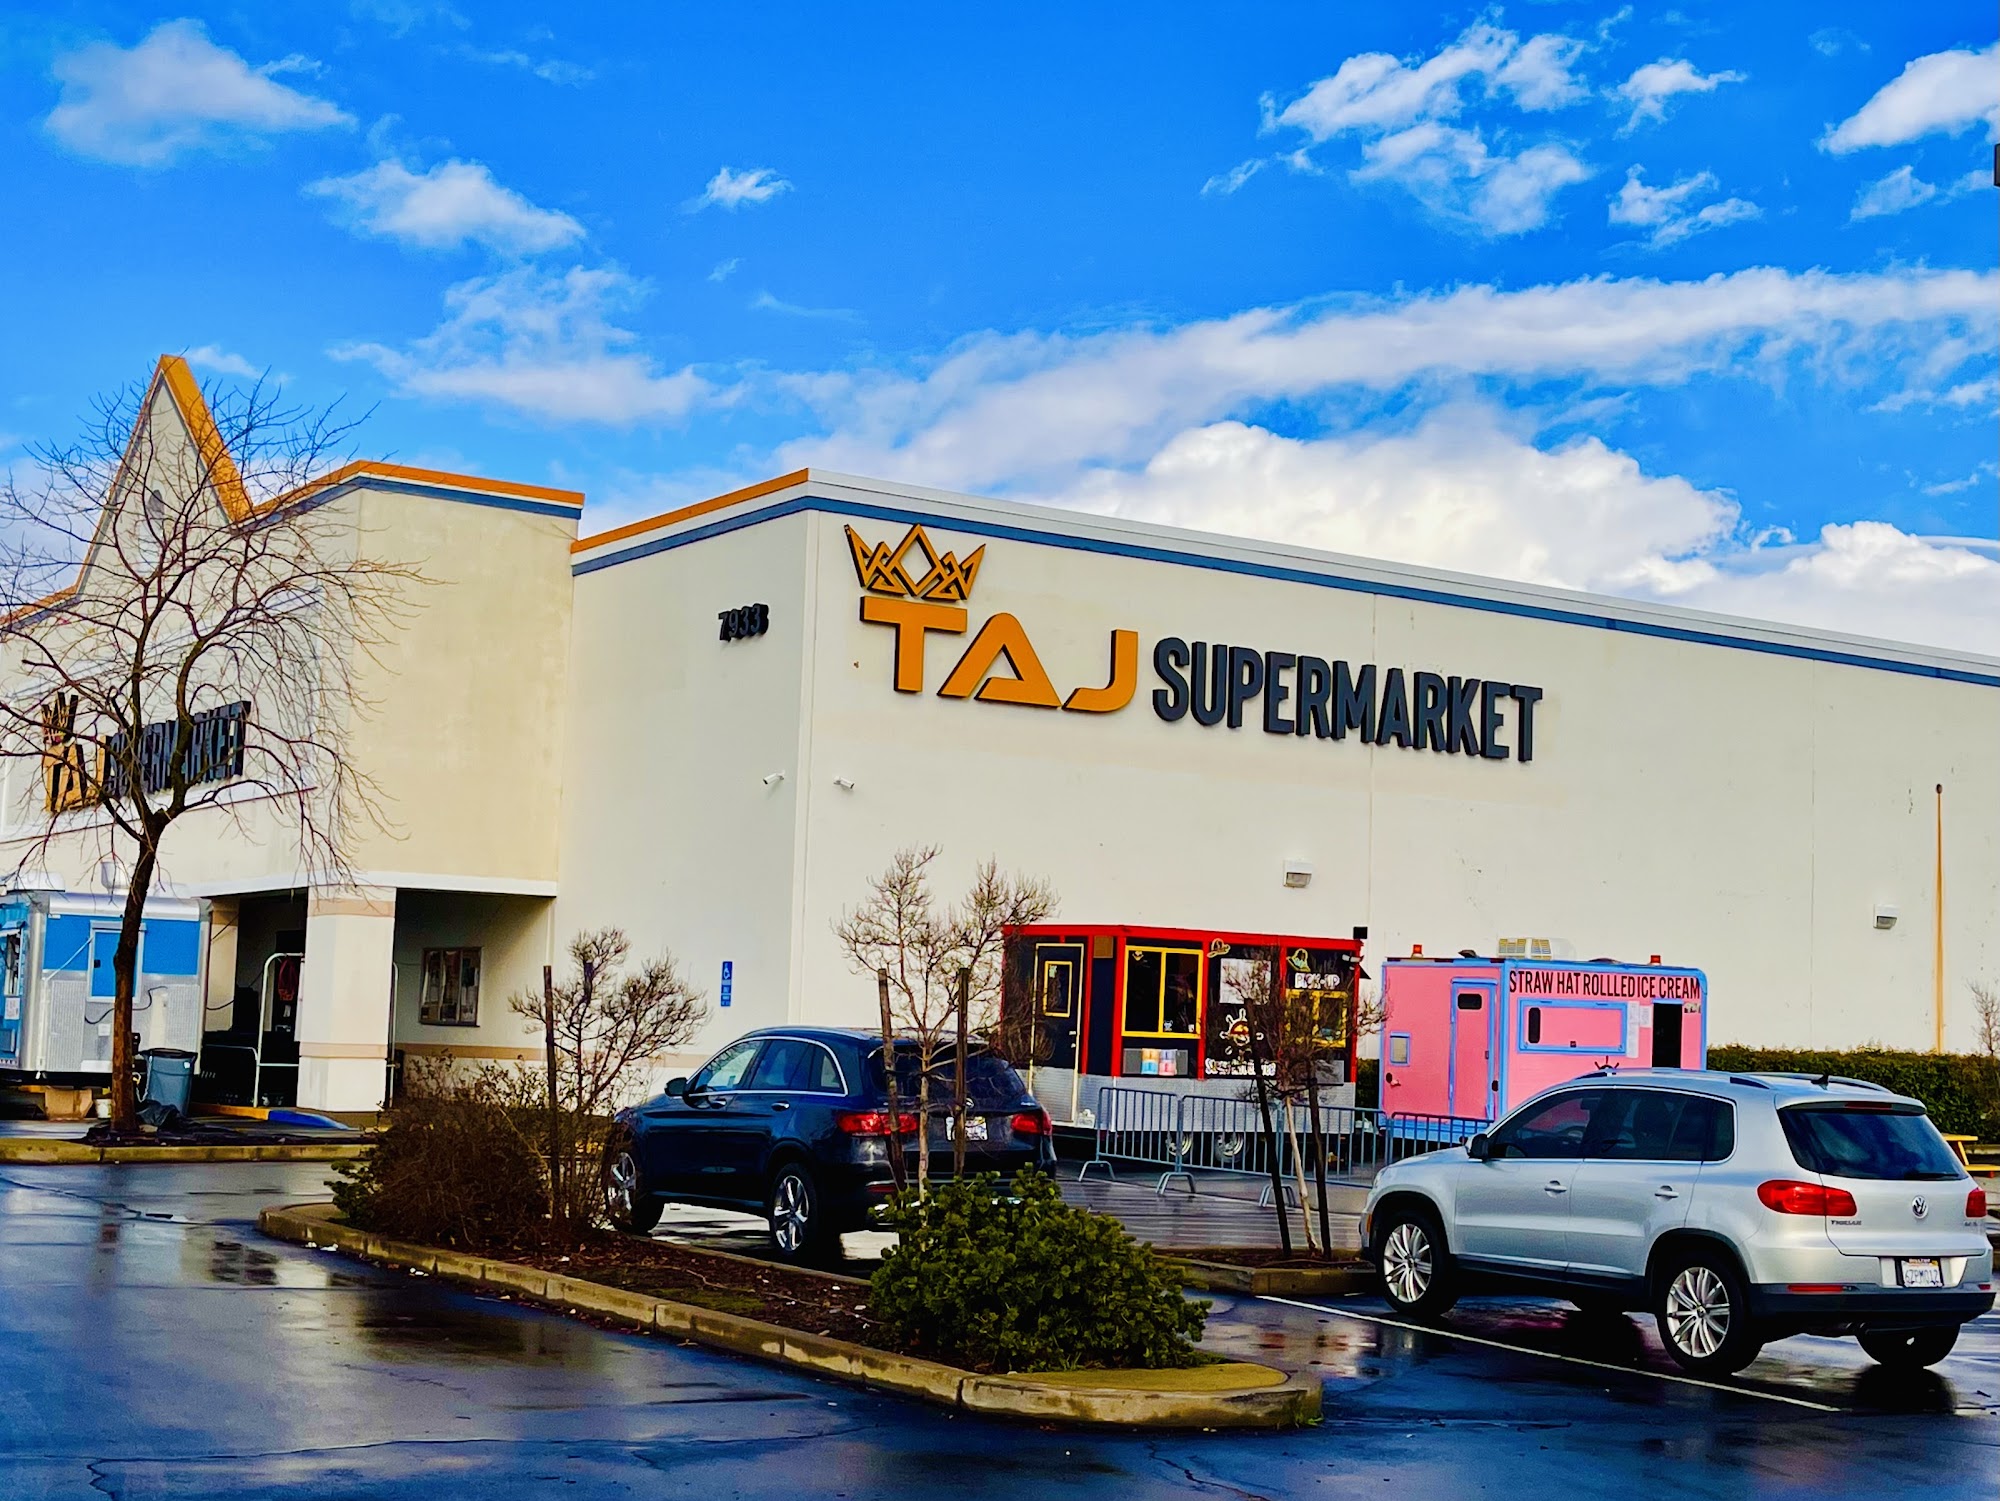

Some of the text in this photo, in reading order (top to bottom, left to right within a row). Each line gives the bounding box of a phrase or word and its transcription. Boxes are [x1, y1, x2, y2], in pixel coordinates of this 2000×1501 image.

[718, 603, 769, 642] 7933
[859, 596, 1543, 762] TAJ SUPERMARKET
[1509, 970, 1555, 994] STRAW
[1557, 972, 1581, 995] HAT
[1658, 977, 1701, 1000] CREAM
